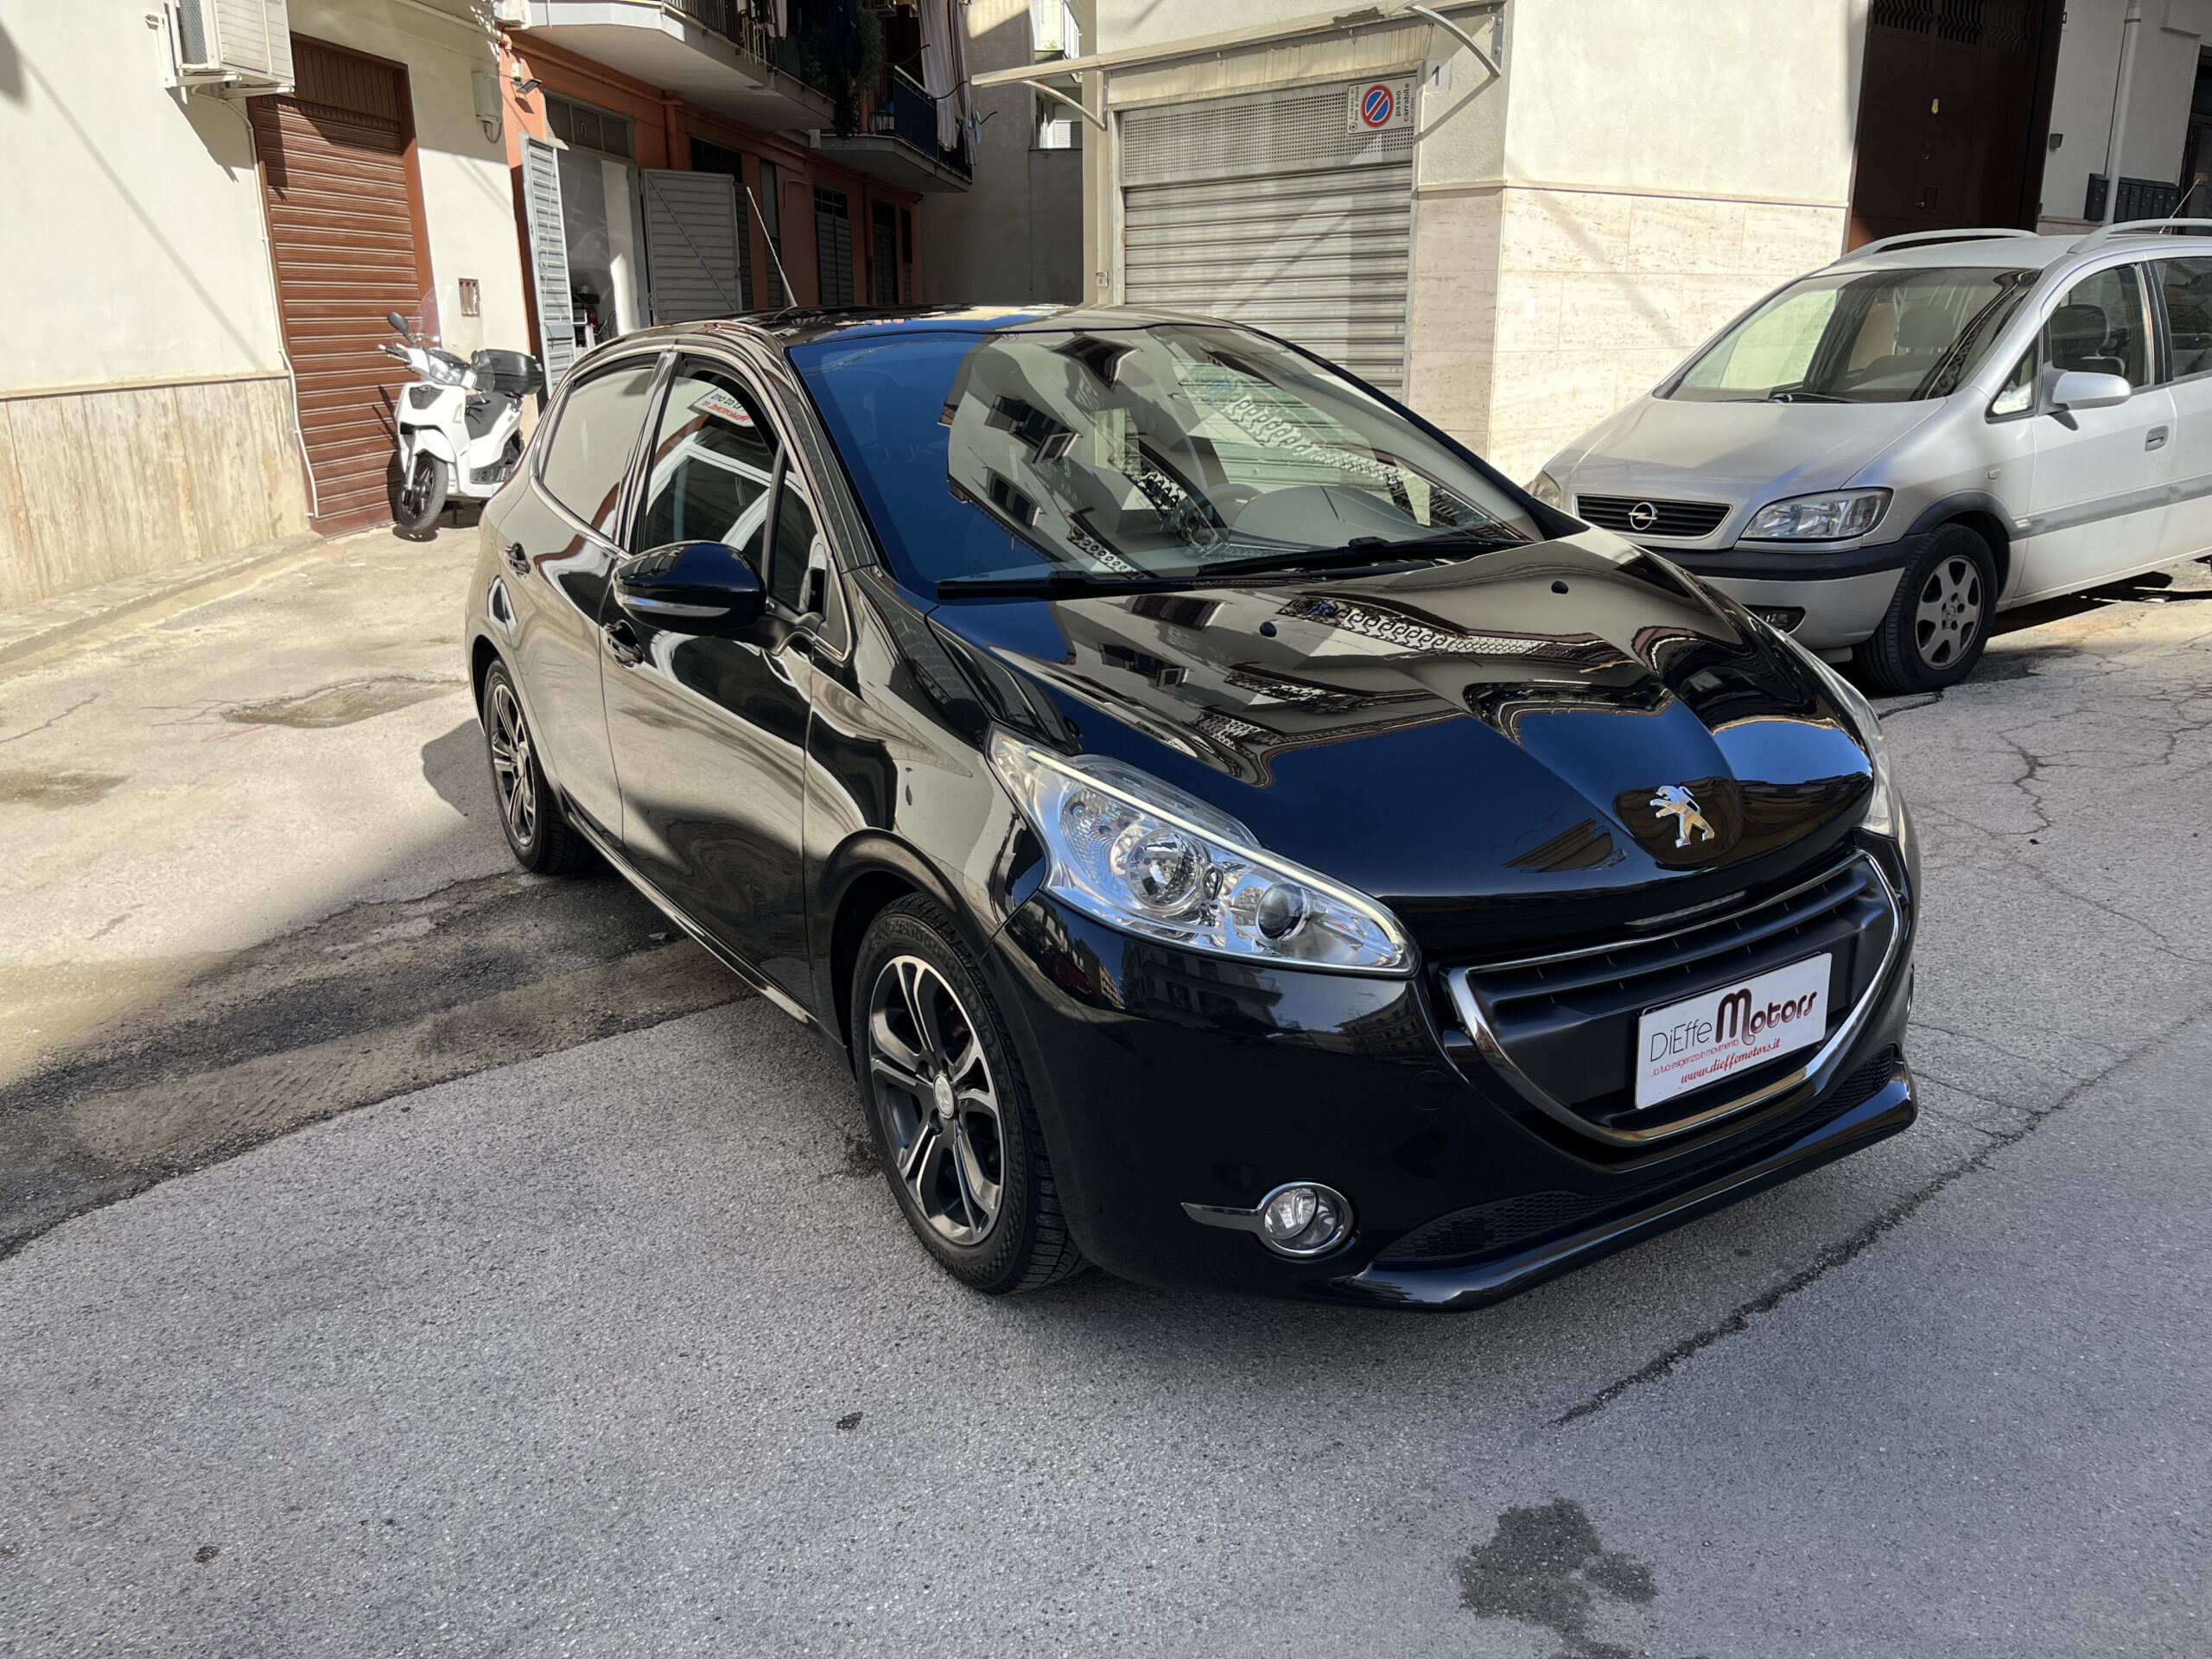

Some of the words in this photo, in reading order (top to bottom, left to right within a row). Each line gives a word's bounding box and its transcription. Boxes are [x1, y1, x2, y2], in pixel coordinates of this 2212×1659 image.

[1649, 1019, 1713, 1062] DiEffe
[1714, 988, 1818, 1046] Motors
[1681, 1037, 1781, 1084] www.dieffemotors.it
